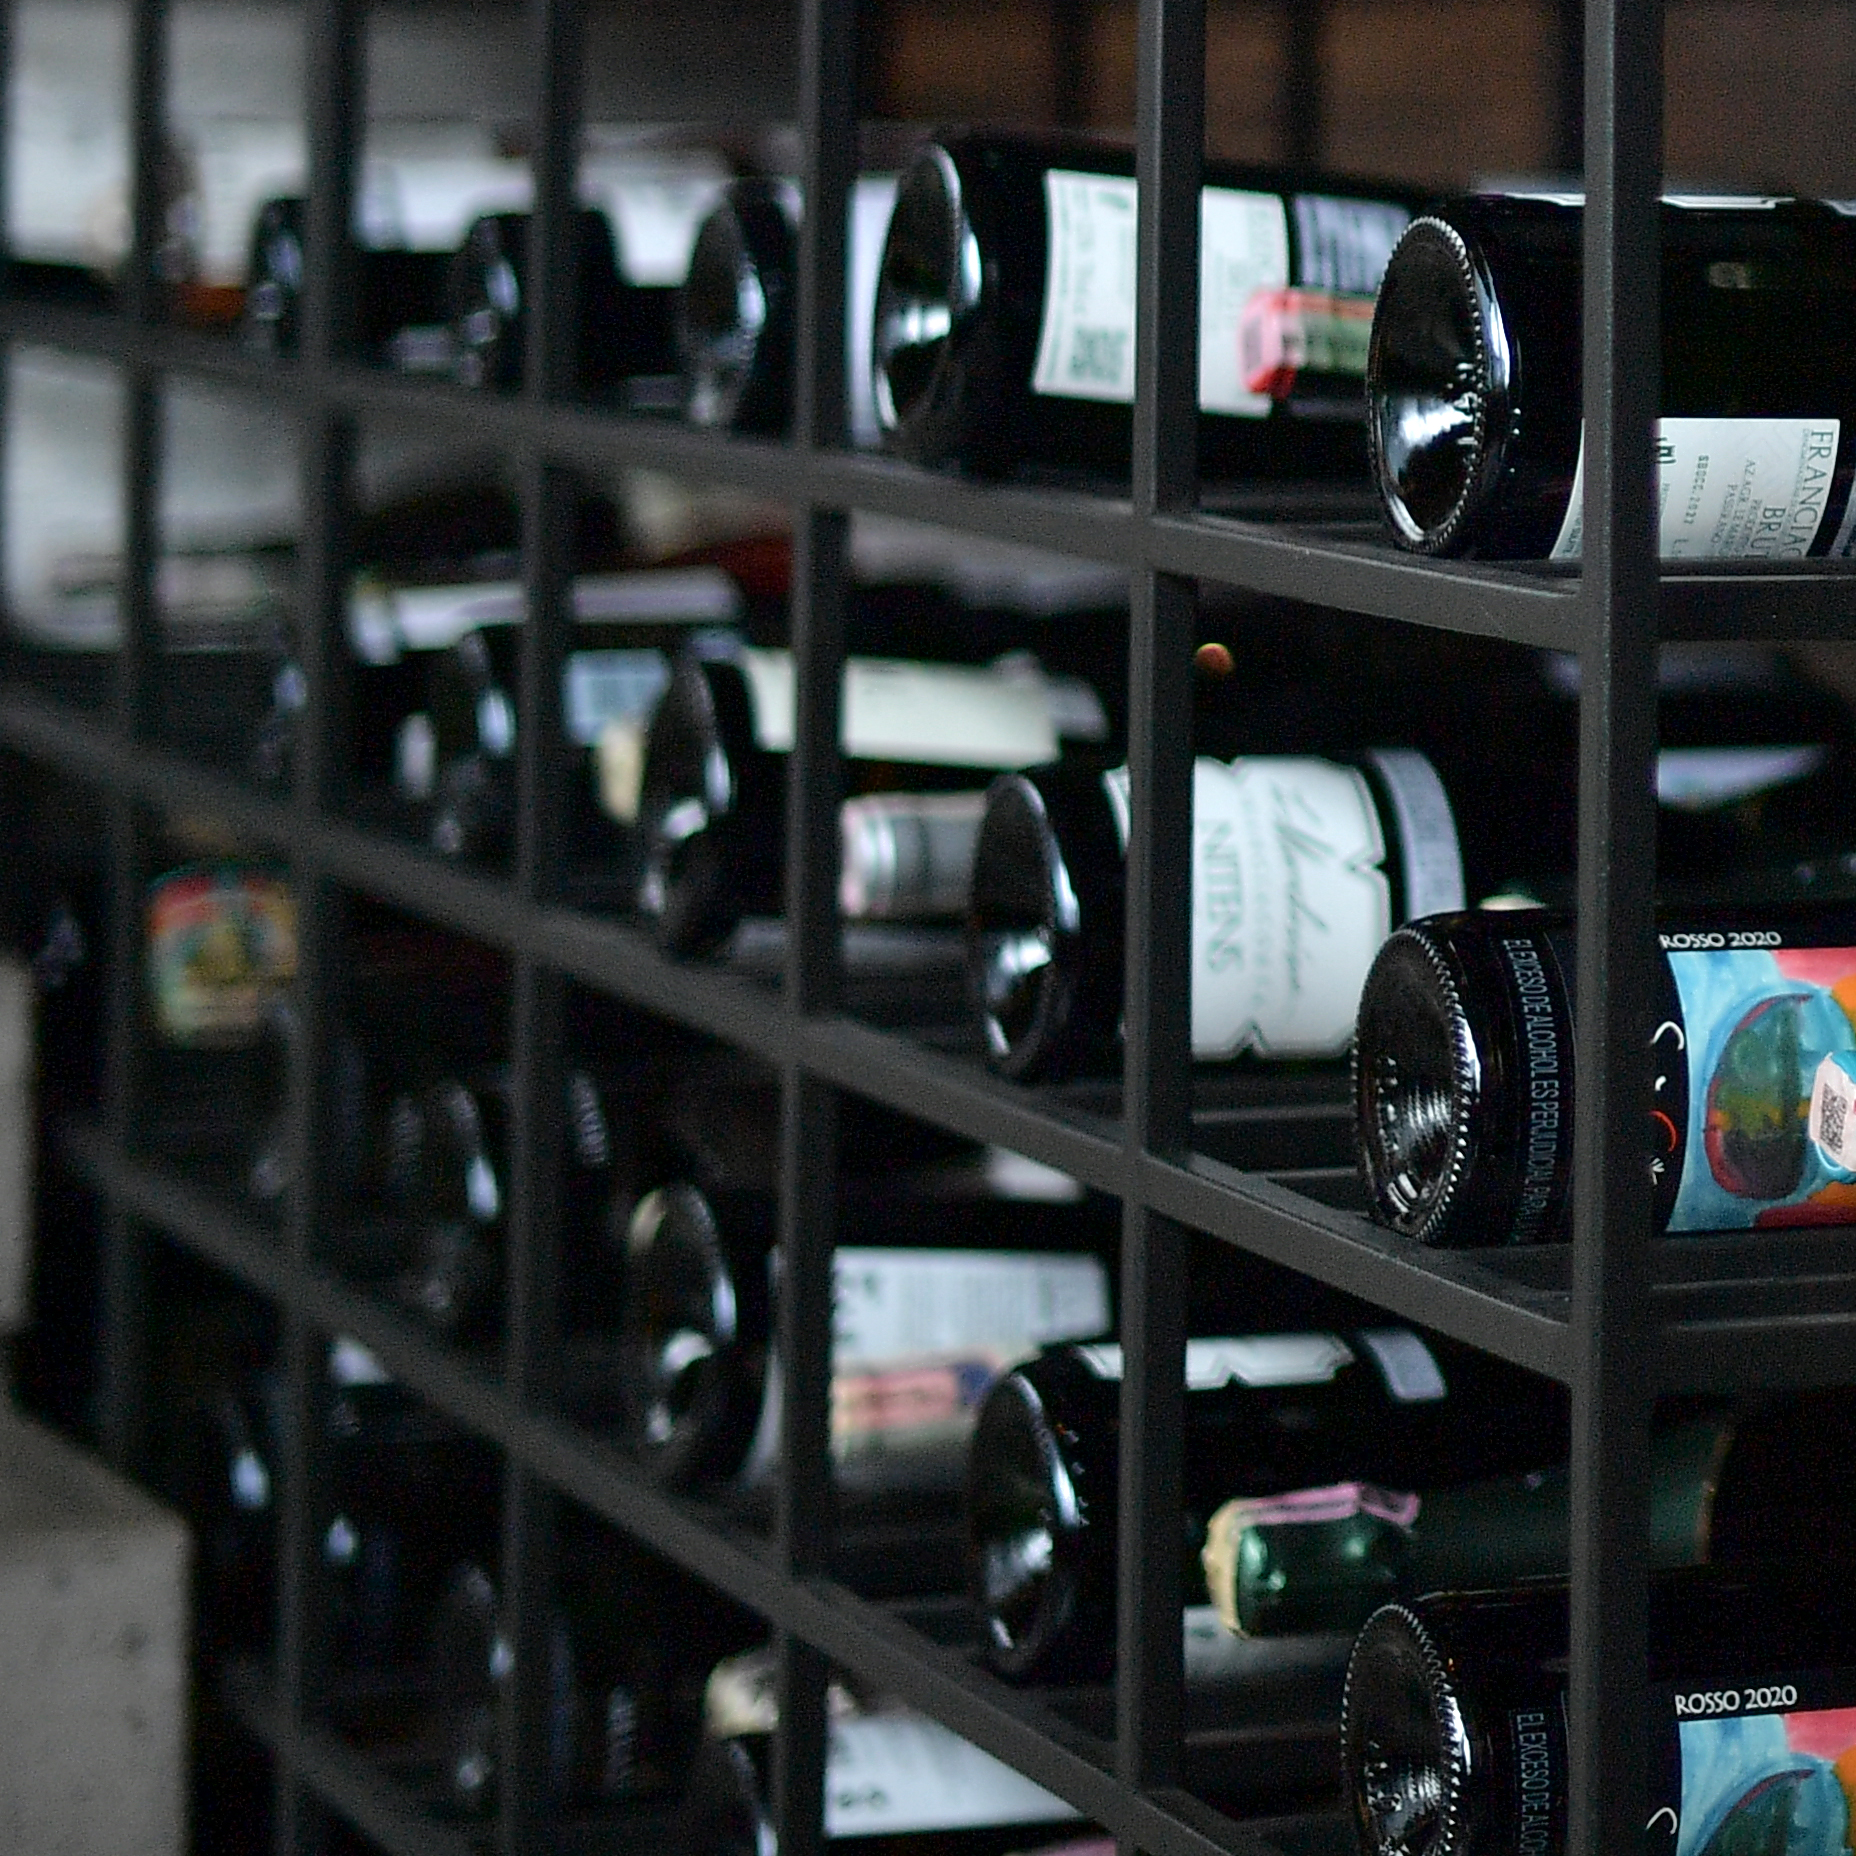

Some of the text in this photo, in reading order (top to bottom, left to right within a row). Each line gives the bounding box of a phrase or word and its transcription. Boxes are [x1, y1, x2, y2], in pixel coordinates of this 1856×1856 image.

[1660, 930, 1783, 949] ROSSO 2020
[1511, 951, 1548, 994] EXCESO
[1522, 995, 1553, 1012] DE
[1525, 1015, 1559, 1077] ALCOHOL
[1531, 1080, 1559, 1099] ES
[1524, 1101, 1559, 1184] PERJUDICIAL
[1674, 1685, 1798, 1717] ROSSO 2020
[1516, 1713, 1545, 1731] EL
[1518, 1732, 1550, 1790] EXCESO
[1521, 1792, 1550, 1812] DE
